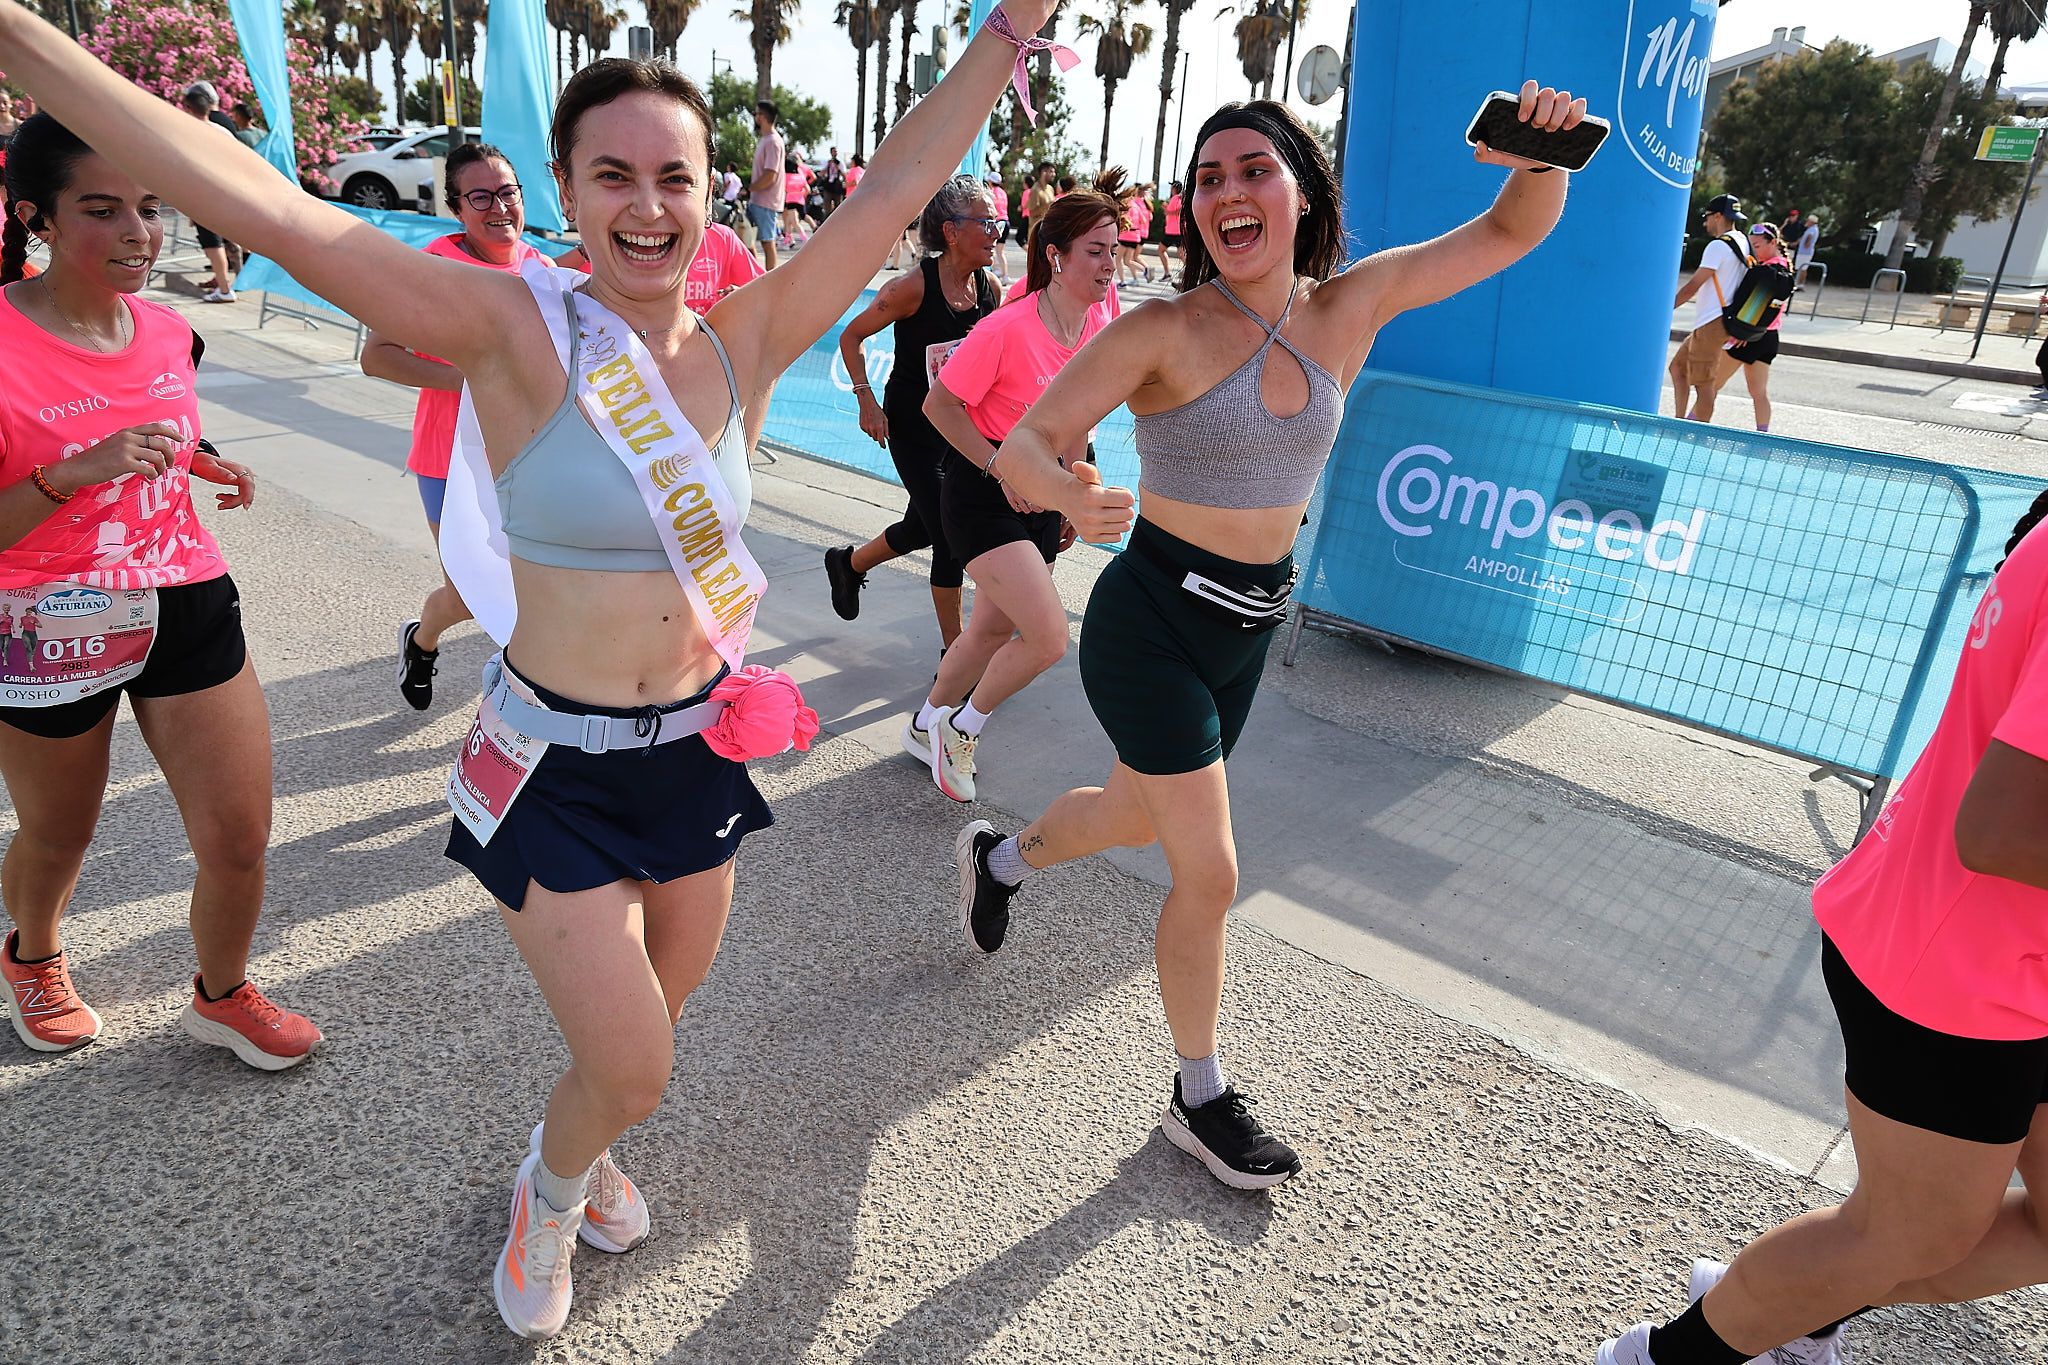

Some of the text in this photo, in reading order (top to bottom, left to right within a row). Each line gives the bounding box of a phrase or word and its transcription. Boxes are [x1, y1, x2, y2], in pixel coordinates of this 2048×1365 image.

[1639, 123, 1665, 162] HIJA
[1668, 152, 1681, 172] DE
[39, 395, 109, 423] OYSHO
[585, 353, 675, 455] FELIZ
[1376, 444, 1706, 576] Compeed
[1464, 555, 1572, 595] AMPOLLAS
[6, 588, 37, 601] SUMA
[41, 600, 108, 612] ASTURIANA
[42, 635, 106, 660] 016
[4, 674, 43, 684] CARRERA
[45, 674, 56, 682] DE
[58, 673, 69, 681] LA
[70, 670, 98, 680] MUJER
[104, 659, 134, 674] VALENCIA
[60, 660, 91, 672] 2983
[5, 689, 61, 700] OYSHO
[91, 670, 130, 691] Santander
[485, 743, 522, 777] CORREDORA
[451, 786, 482, 825] Santander
[464, 776, 491, 808] VALENCIA
